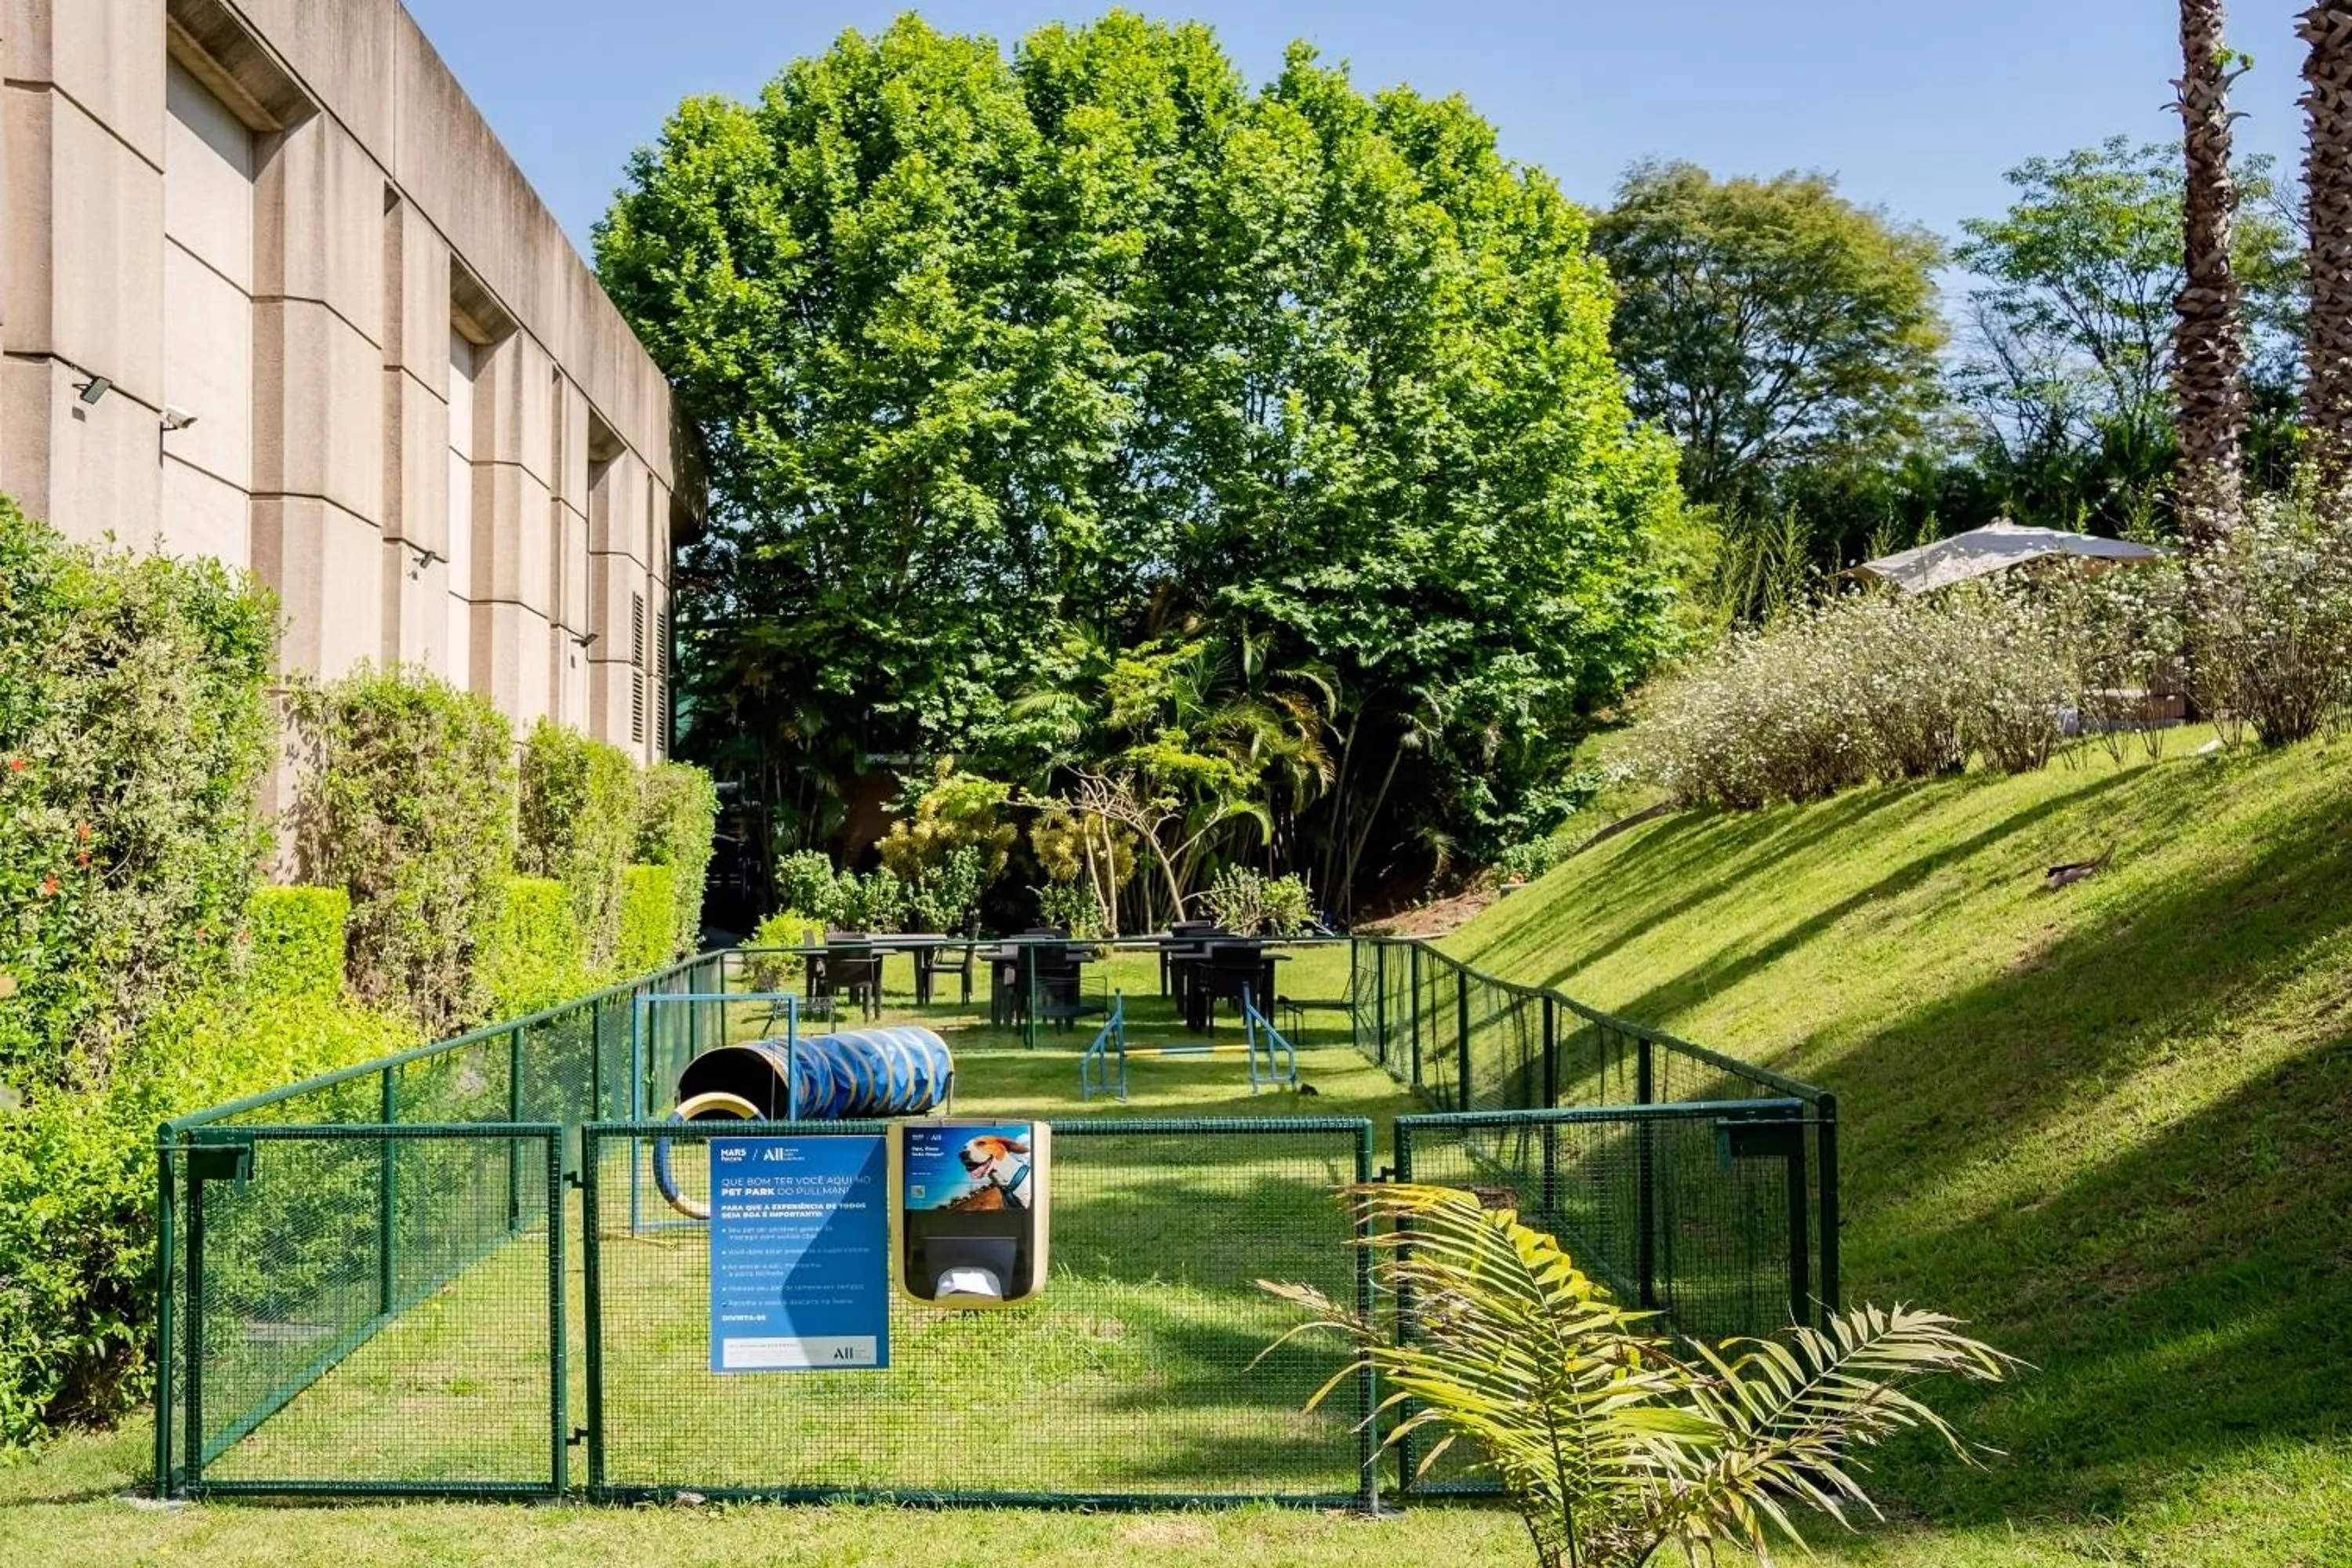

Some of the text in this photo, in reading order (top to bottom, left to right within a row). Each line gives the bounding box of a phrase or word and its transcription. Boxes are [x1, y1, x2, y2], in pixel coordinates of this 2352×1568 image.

[763, 1147, 783, 1161] All
[747, 1178, 771, 1186] BOM
[774, 1177, 793, 1185] TER
[796, 1175, 826, 1185] VOCÊ
[826, 1176, 852, 1185] AQUI
[855, 1175, 871, 1184] NO
[721, 1188, 742, 1196] PET
[833, 1347, 852, 1359] All
